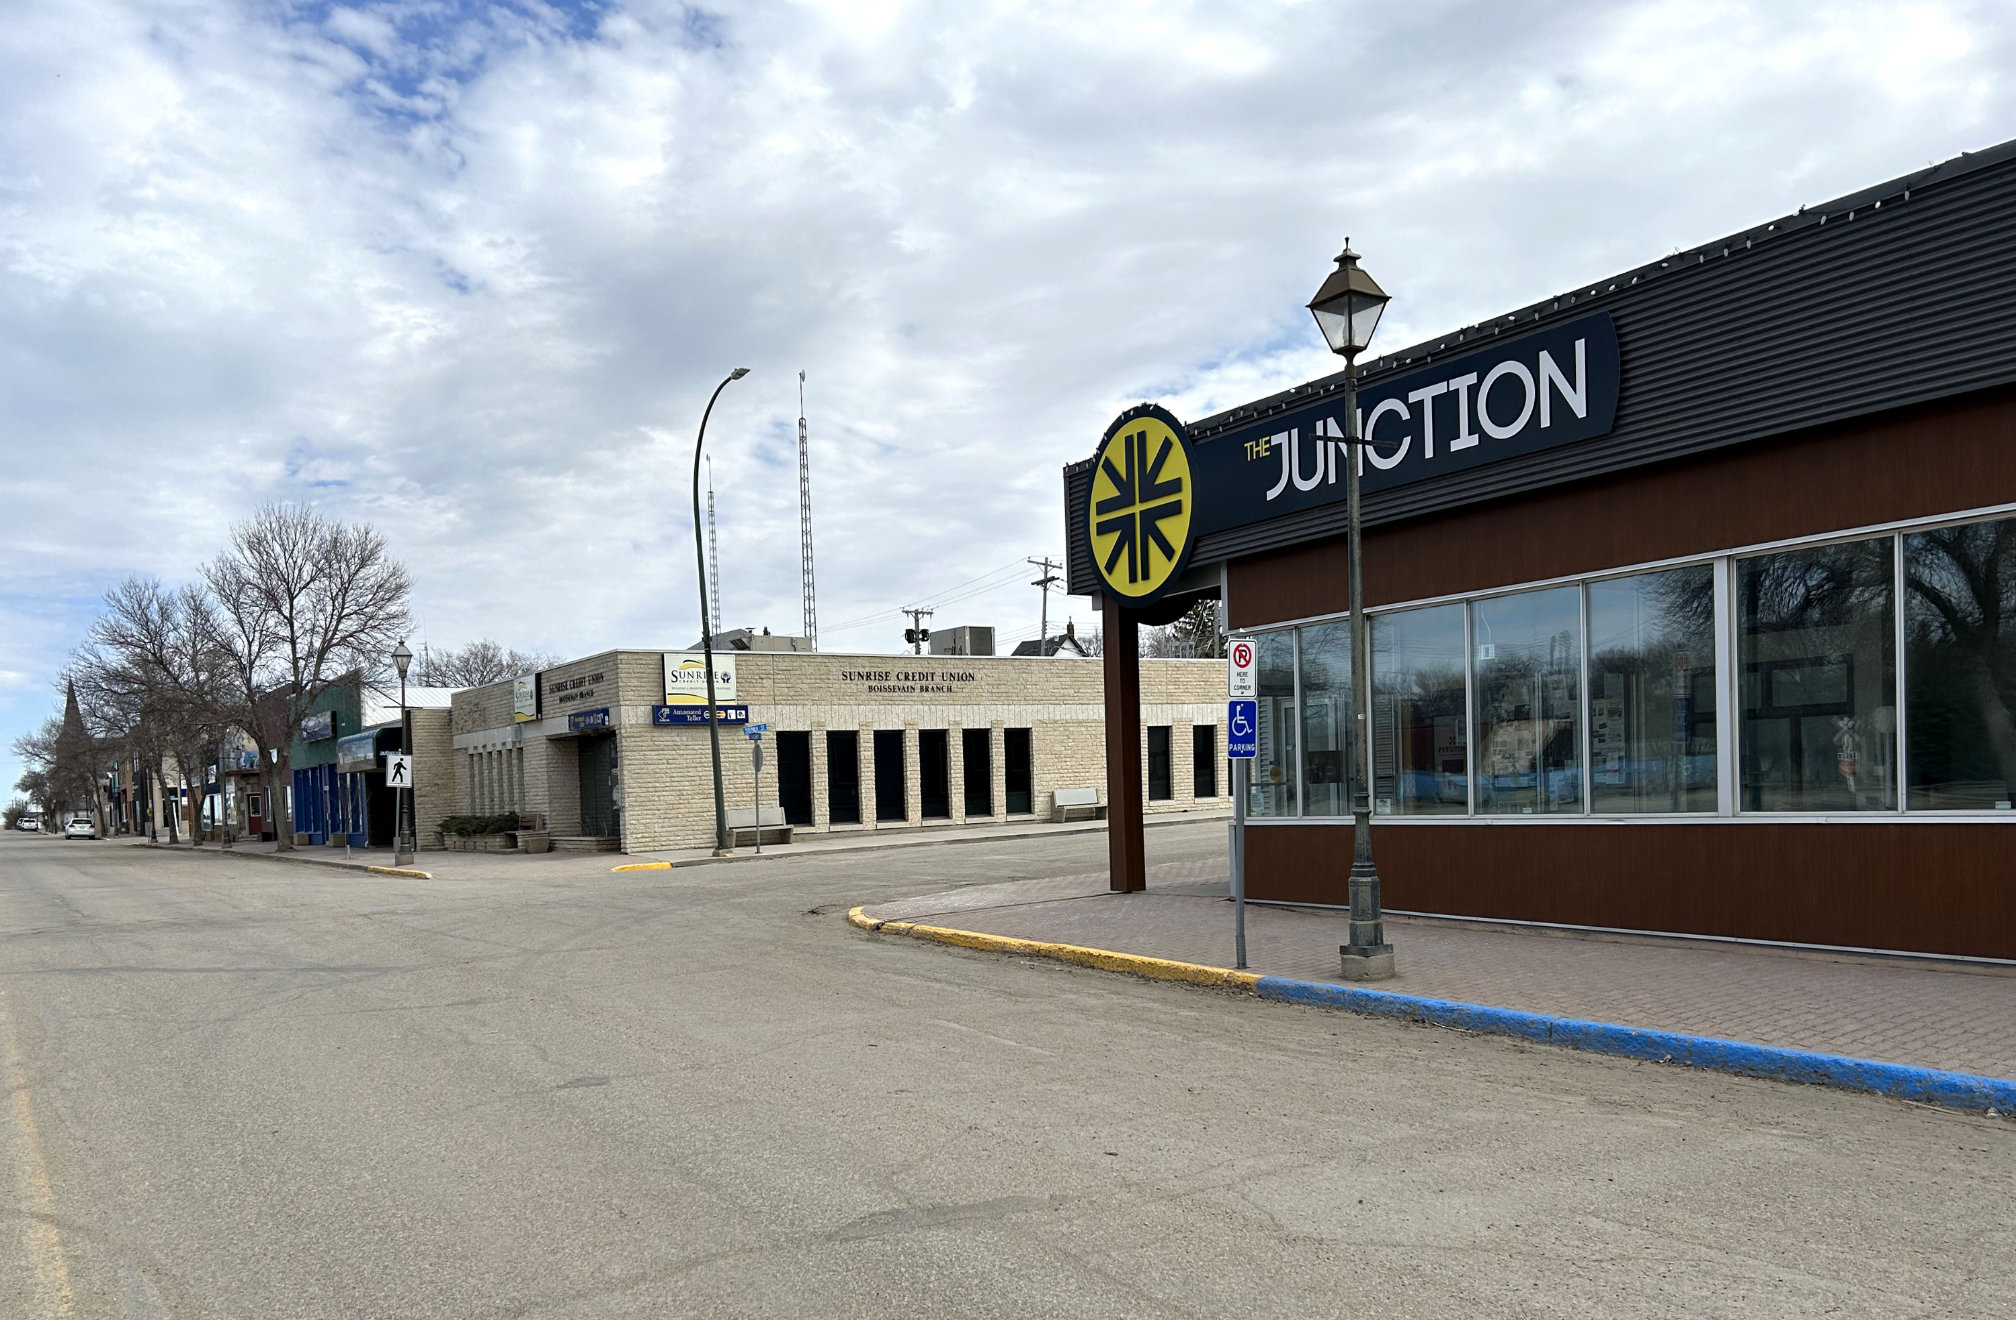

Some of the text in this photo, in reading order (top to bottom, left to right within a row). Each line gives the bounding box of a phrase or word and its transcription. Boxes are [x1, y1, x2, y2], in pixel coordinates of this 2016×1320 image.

[1266, 338, 1587, 501] JUNCTION
[1244, 436, 1270, 461] THE
[671, 669, 719, 683] SUNRIE
[841, 671, 975, 682] SUNRISE CREDIT UNION
[868, 685, 952, 693] BOISSEVAIN BRANCH
[1229, 743, 1255, 752] PARKING
